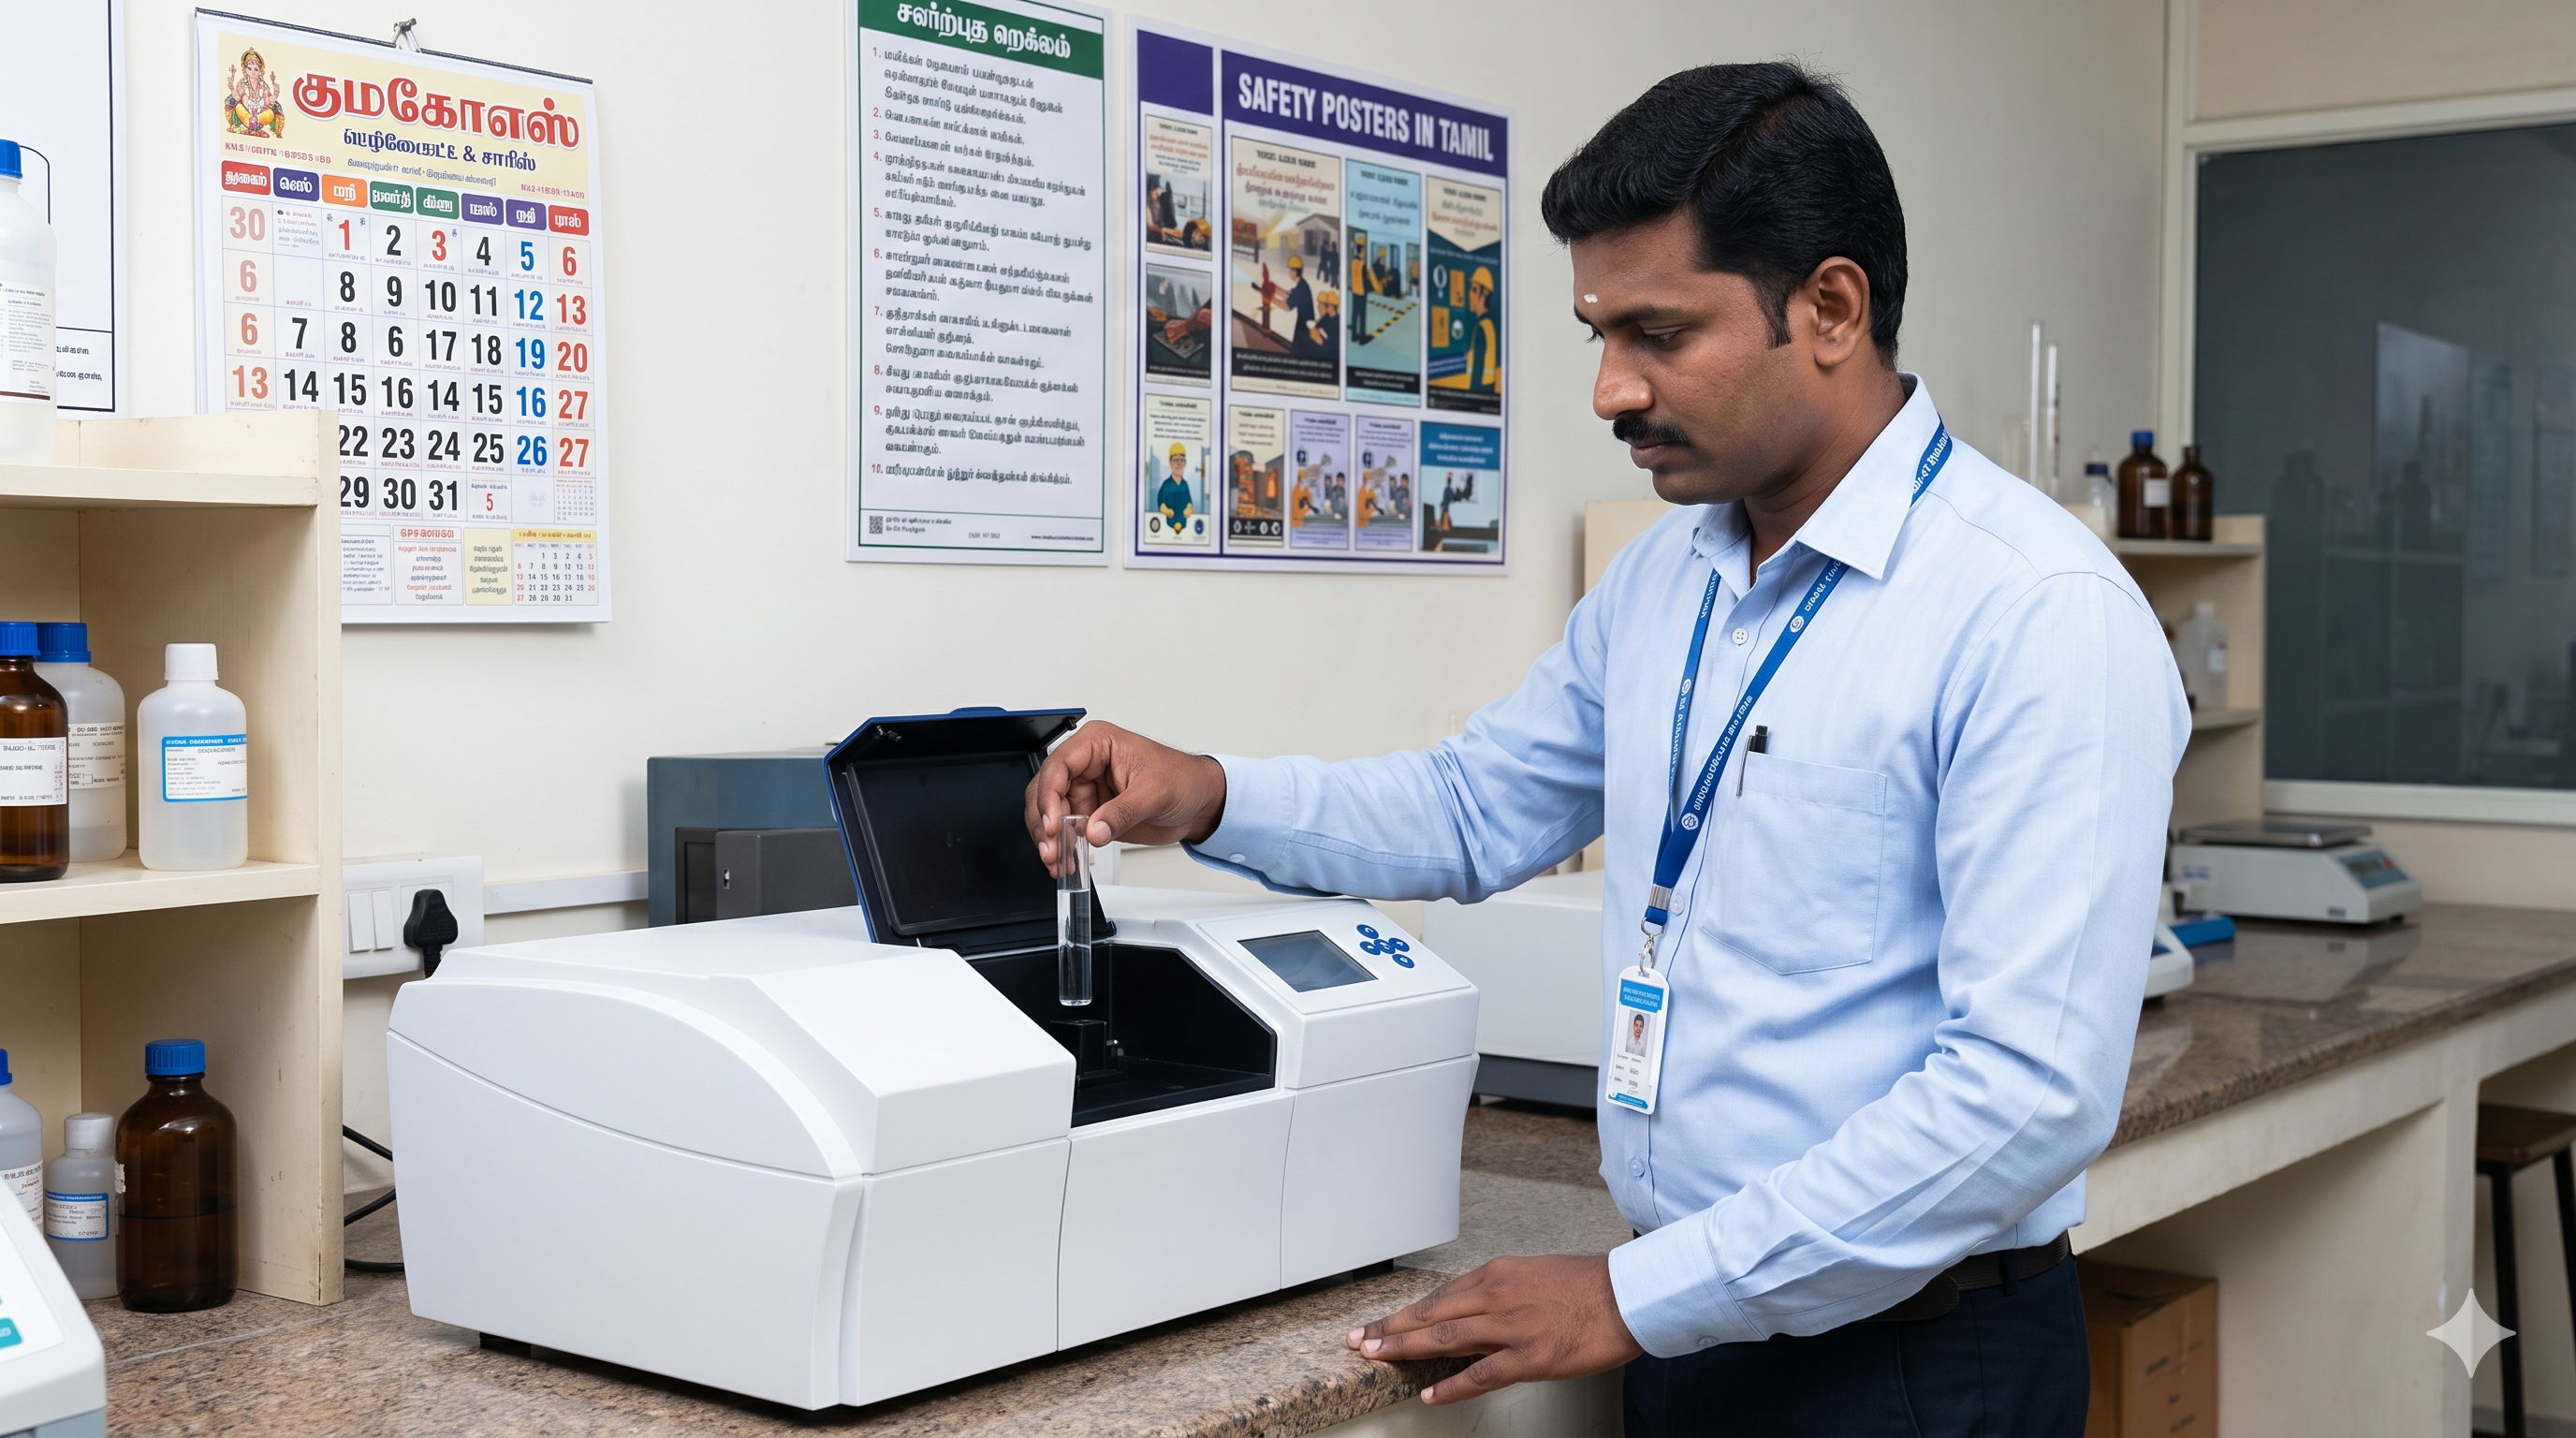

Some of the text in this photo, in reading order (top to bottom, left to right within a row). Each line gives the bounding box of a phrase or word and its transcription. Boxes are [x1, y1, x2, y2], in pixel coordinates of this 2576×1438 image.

[872, 47, 882, 58] 1.
[872, 108, 882, 118] 2.
[1239, 73, 1493, 161] SAFETY POSTERS IN TAMIL
[873, 129, 882, 140] 3.
[463, 146, 476, 162] &
[873, 151, 882, 162] 4.
[873, 208, 882, 218] 5.
[230, 207, 265, 241] 30
[339, 220, 349, 250] 1
[387, 225, 401, 256] 2
[432, 230, 446, 261] 3
[476, 237, 490, 266] 4
[521, 242, 534, 271] 5
[564, 247, 576, 275] 6
[873, 248, 883, 259] 6.
[241, 260, 586, 325] 6 8 9 10 11 12 13
[874, 306, 883, 316] 7.
[242, 313, 587, 373] 6 7 8 6 17 18 19 20
[874, 365, 883, 375] 8.
[233, 365, 588, 419] 13 14 15 16 14 15 16 27
[340, 425, 589, 467] 22 23 24 25 26 27
[341, 476, 493, 511] 29 30 31 5
